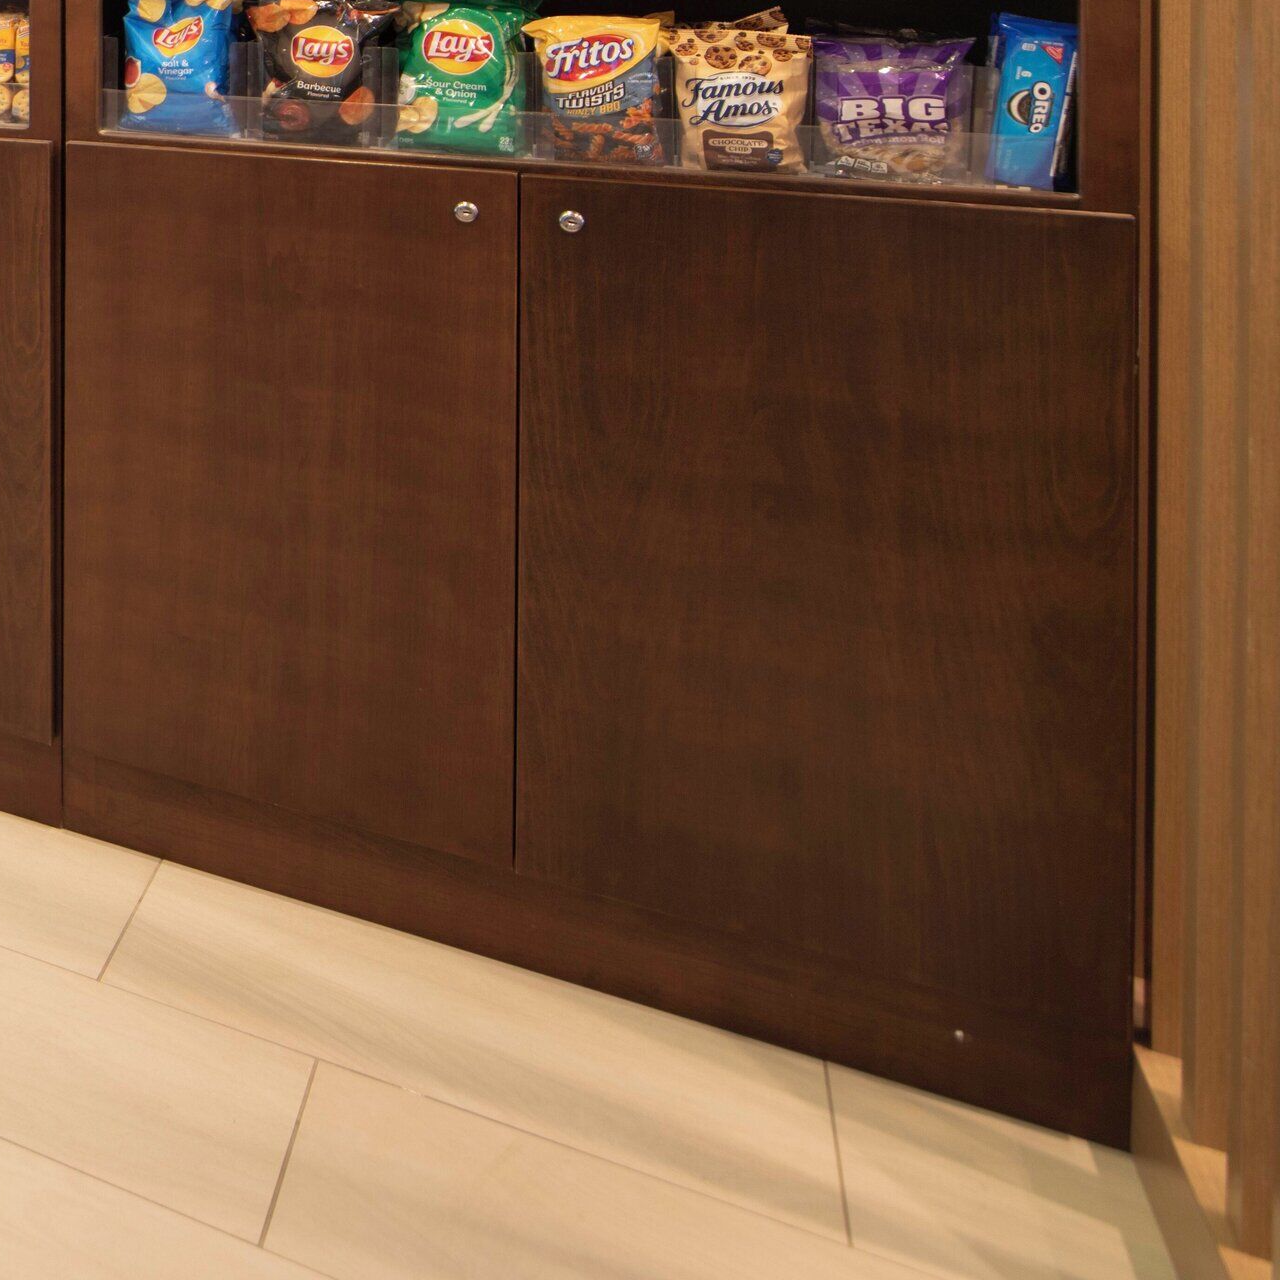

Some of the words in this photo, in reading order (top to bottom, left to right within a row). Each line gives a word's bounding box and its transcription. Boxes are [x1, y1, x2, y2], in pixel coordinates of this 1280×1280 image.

[155, 18, 202, 48] Lay's
[295, 40, 351, 65] Lay's
[429, 32, 492, 62] Lay's
[546, 36, 635, 78] Fritos
[157, 67, 194, 76] Vinegar
[297, 80, 342, 94] Barbecue
[426, 78, 452, 90] Sour
[453, 80, 487, 91] Cream
[445, 88, 477, 99] Onion
[555, 83, 625, 109] TWISTS
[568, 81, 614, 100] FLAVOR
[682, 78, 785, 108] Famous
[600, 101, 621, 114] BBQ
[690, 99, 779, 125] Amos
[840, 97, 946, 121] BIG
[1029, 81, 1052, 133] OREO
[711, 138, 766, 147] CHOCOLATE
[836, 119, 949, 143] TEXAS
